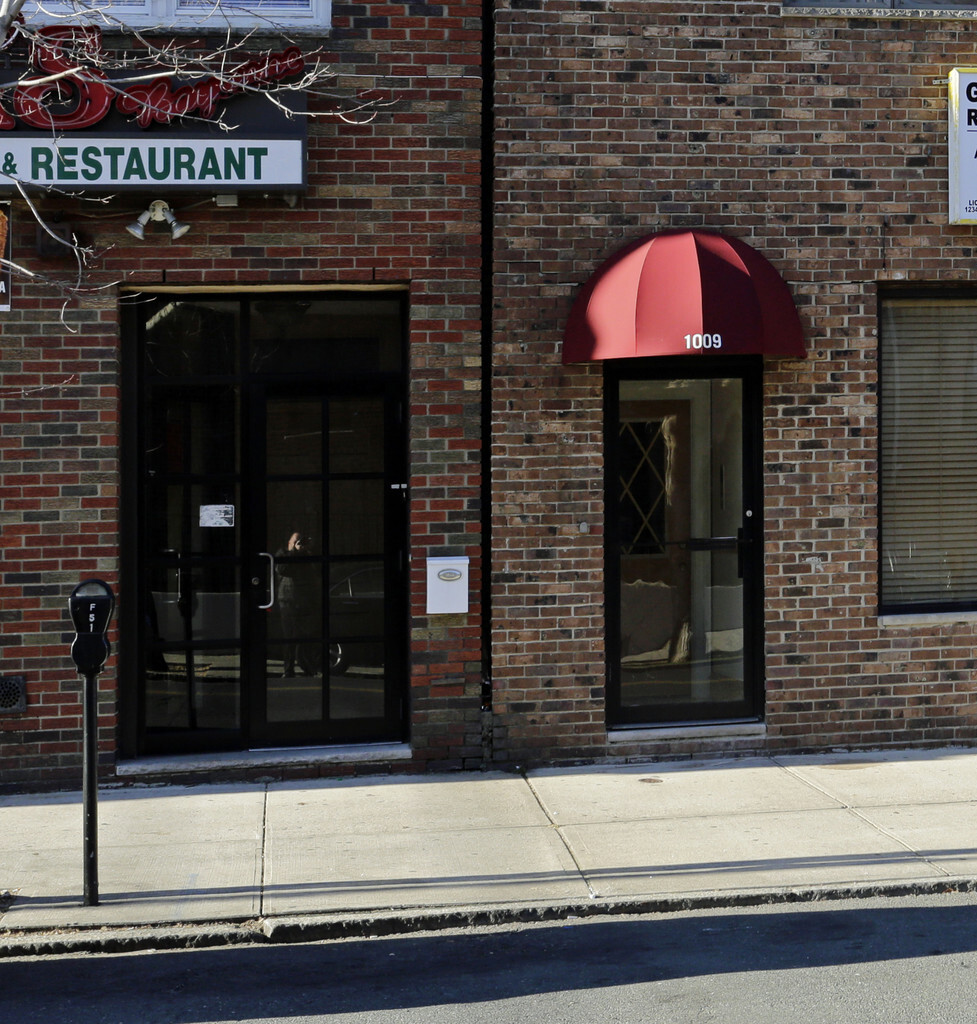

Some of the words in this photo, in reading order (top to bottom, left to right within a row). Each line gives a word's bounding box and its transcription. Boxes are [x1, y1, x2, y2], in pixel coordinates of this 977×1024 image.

[2, 151, 18, 175] &
[30, 145, 268, 181] RESTAURANT
[683, 333, 723, 350] 1009
